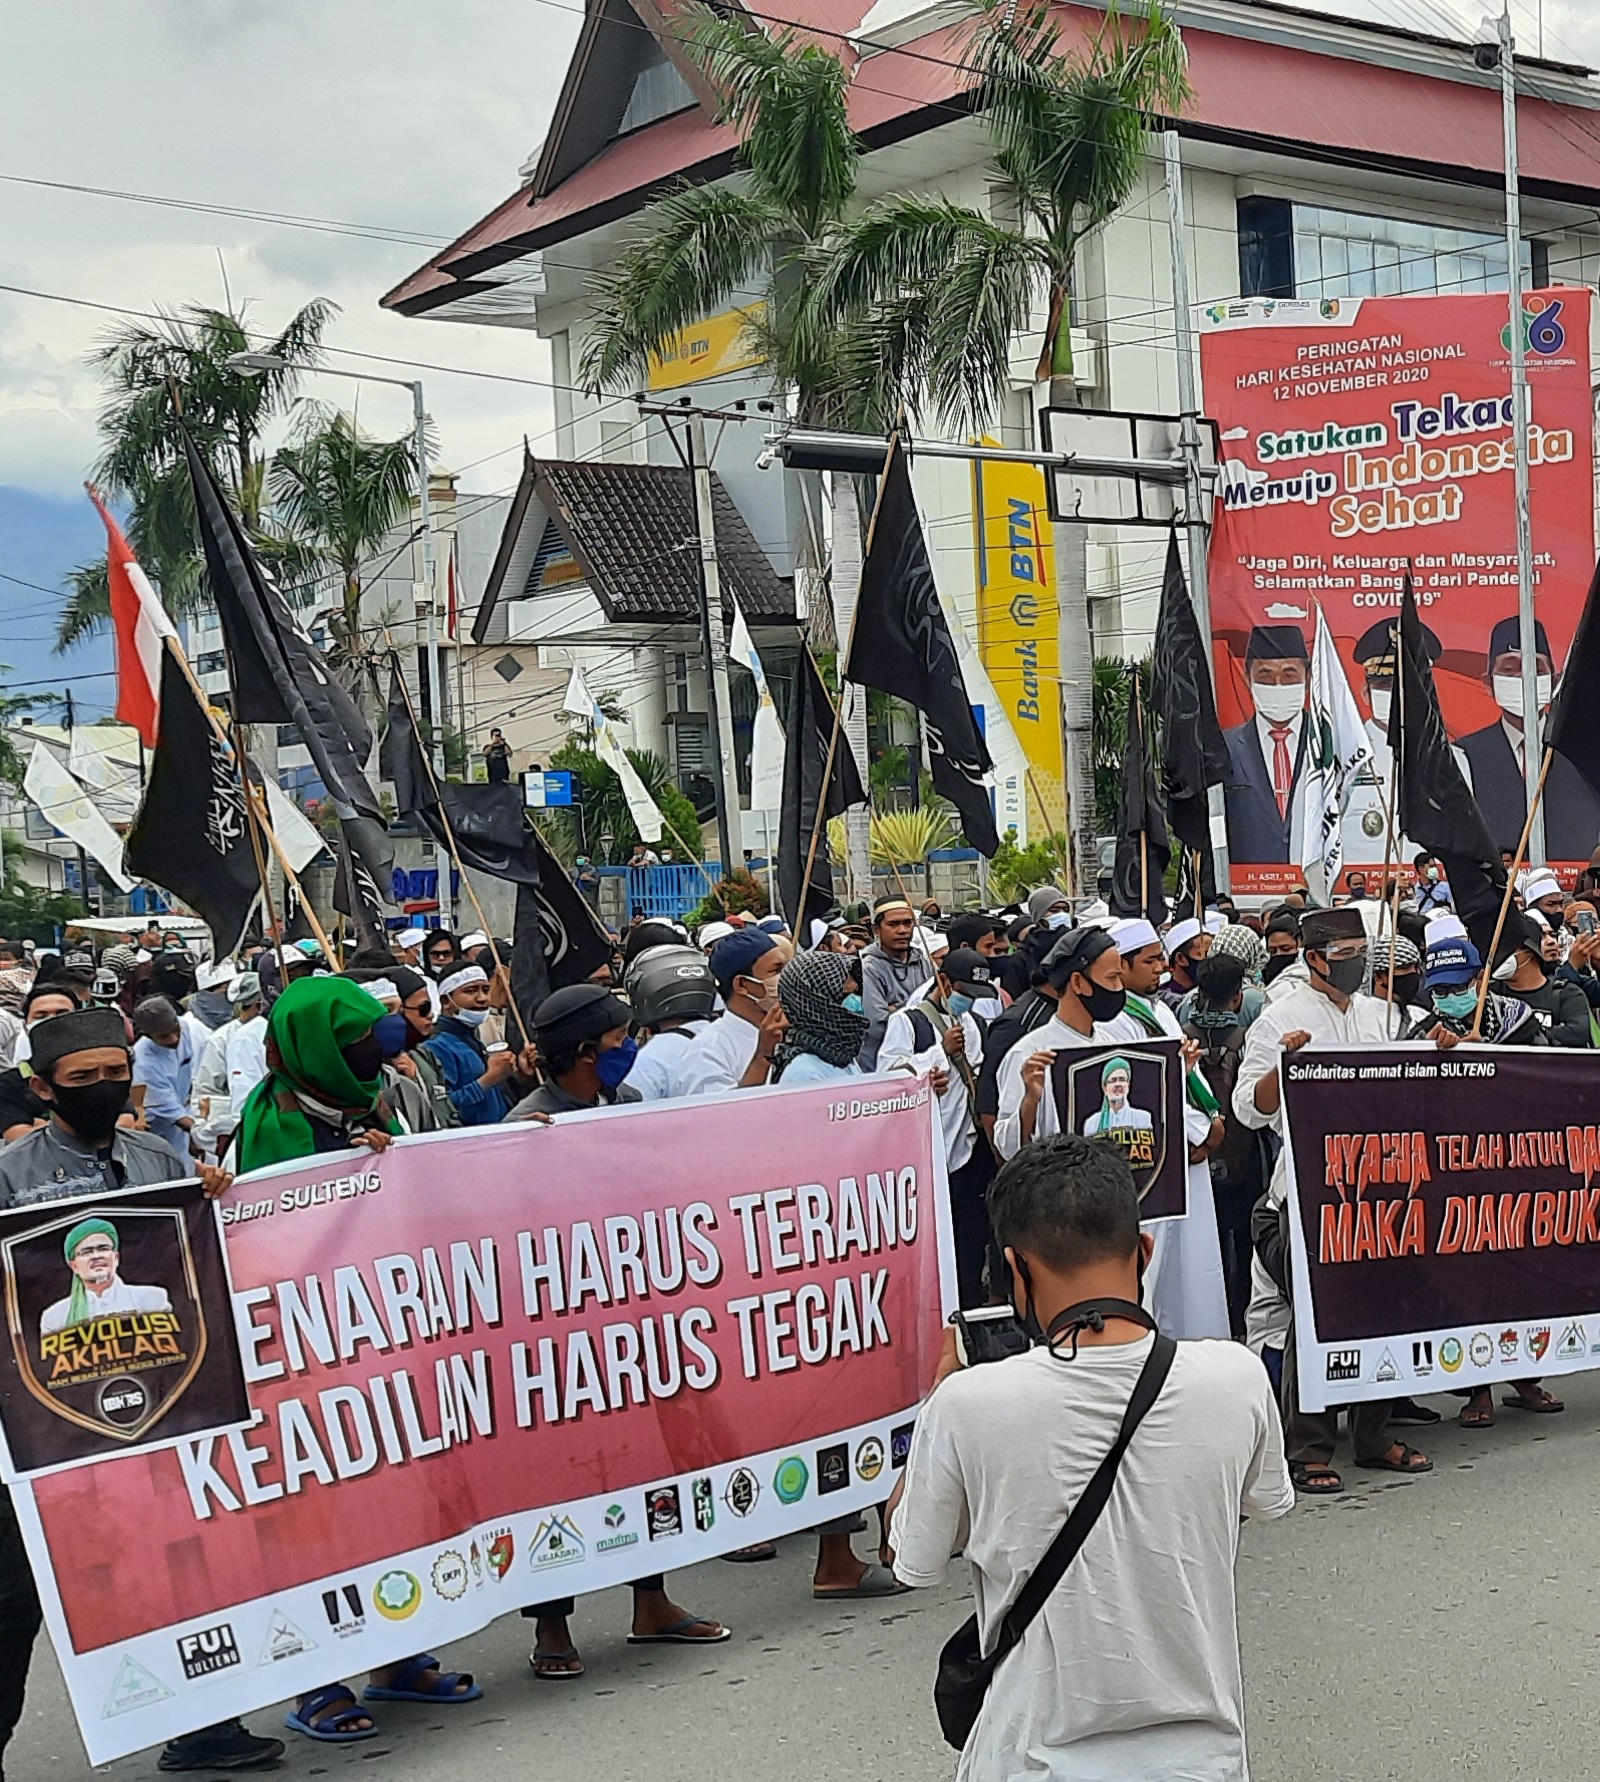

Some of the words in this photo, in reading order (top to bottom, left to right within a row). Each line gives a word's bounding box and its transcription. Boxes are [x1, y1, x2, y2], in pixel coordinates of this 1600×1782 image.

[1236, 368, 1275, 389] HARI
[1278, 355, 1385, 382] KESEHATAN
[1383, 342, 1466, 370] NASIONAL
[1297, 334, 1403, 361] PERINGATAN
[1273, 385, 1290, 400] 12
[1294, 373, 1389, 398] NOVEMBER
[1393, 367, 1429, 385] 2020
[1257, 421, 1385, 461] Satukan
[1223, 471, 1335, 508] Menuju
[1346, 430, 1571, 492] Indonesia
[1331, 486, 1462, 537] Sehat
[1008, 498, 1034, 582] BTN
[1293, 554, 1328, 570] Diri,
[1332, 555, 1409, 571] Keluarga
[1414, 553, 1447, 567] dan
[1451, 552, 1556, 570] Masyaraat,
[1254, 572, 1356, 590] Selamatkan
[1360, 573, 1424, 589] Banga
[1428, 571, 1463, 586] dari
[1467, 570, 1541, 587] Pandei
[1017, 638, 1040, 724] Bank
[1288, 1064, 1356, 1080] Solidaritas
[1359, 1064, 1402, 1079] ummat
[1404, 1062, 1437, 1078] islam
[1440, 1062, 1496, 1078] SULTENG
[827, 1101, 847, 1121] 18
[1324, 1131, 1432, 1196] NYAWA
[1435, 1134, 1504, 1172] TELAH
[1507, 1130, 1565, 1168] JATUH
[222, 1199, 274, 1225] slam
[280, 1171, 382, 1212] SULTENG
[1319, 1199, 1427, 1264] MAKA
[1436, 1190, 1530, 1255] DIAM
[234, 1237, 500, 1384] ENARAN
[517, 1202, 722, 1318] HARUS
[728, 1166, 919, 1276] TERANG
[40, 1313, 182, 1361] REVOLUSI
[51, 1334, 181, 1379] AKHLAQ
[1329, 1351, 1358, 1368] FUI
[176, 1348, 493, 1521] KEADILAN
[511, 1309, 721, 1428] HARUS
[727, 1268, 891, 1381] TEGAK
[181, 1625, 233, 1661] FUI
